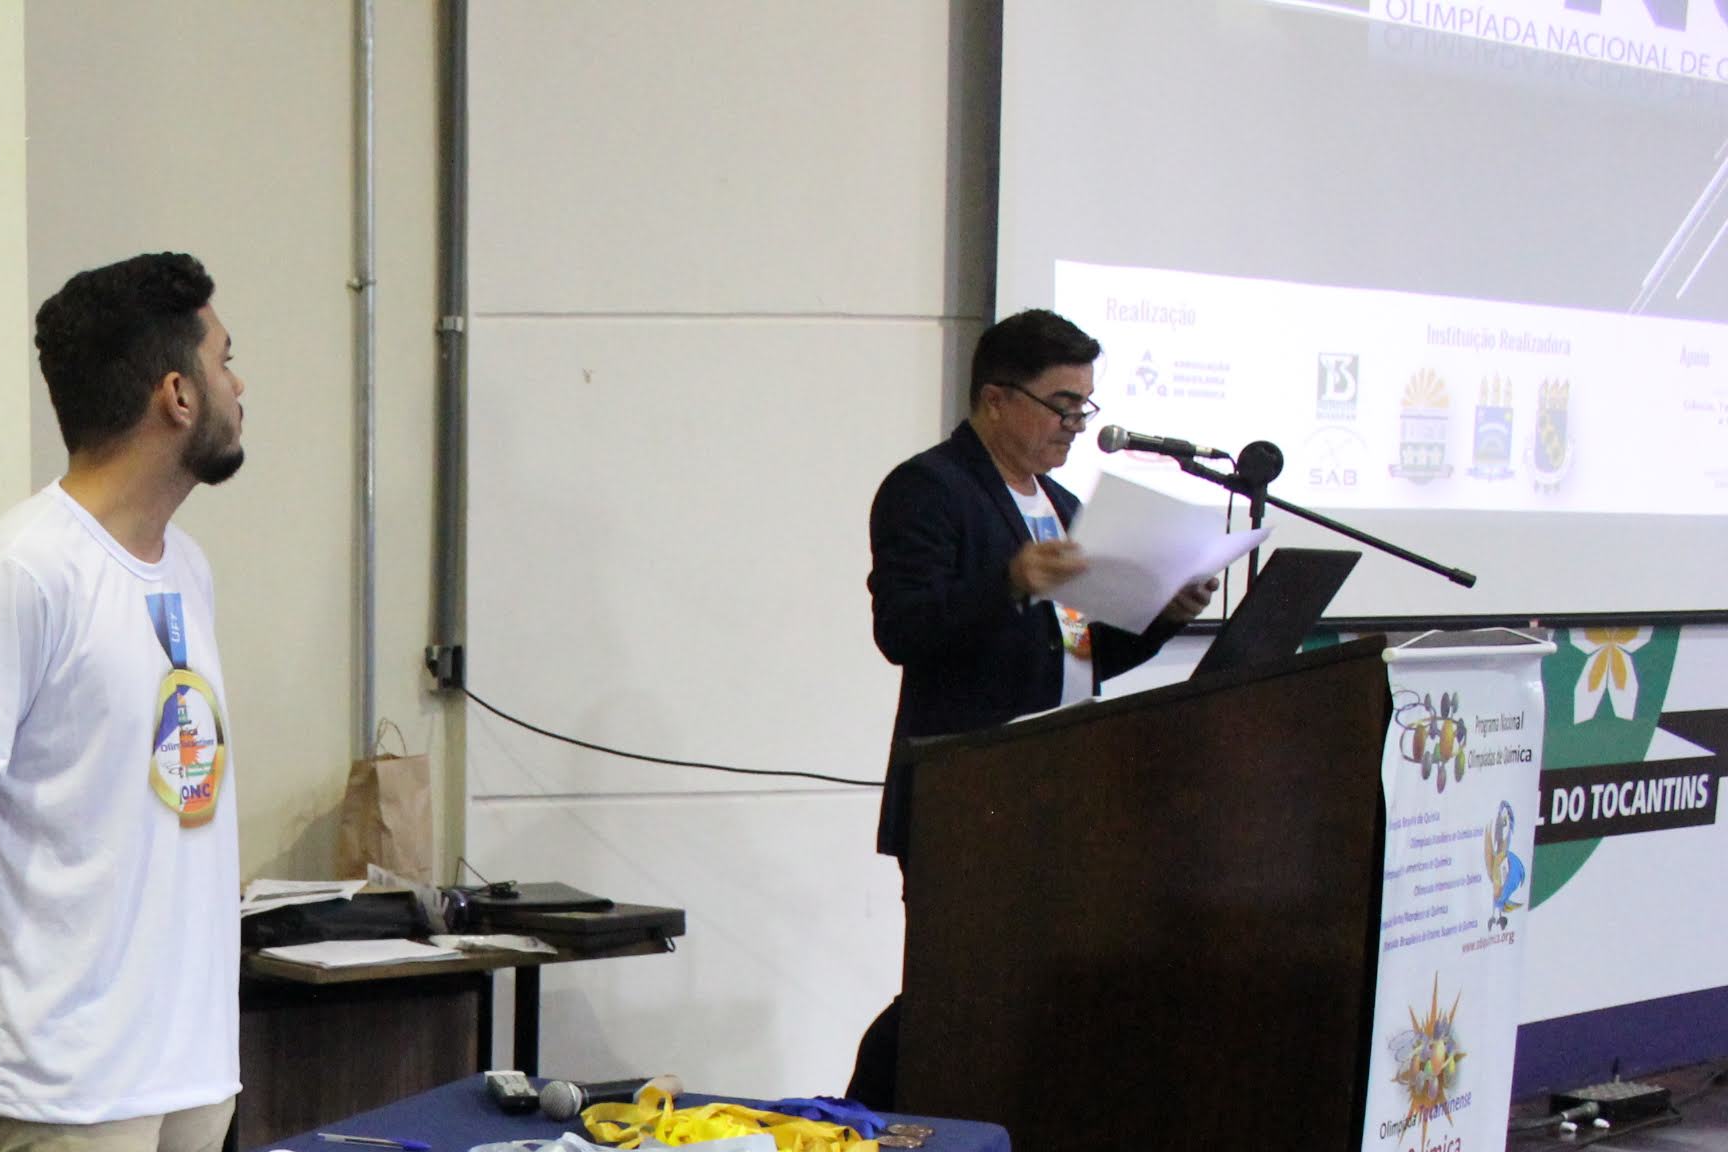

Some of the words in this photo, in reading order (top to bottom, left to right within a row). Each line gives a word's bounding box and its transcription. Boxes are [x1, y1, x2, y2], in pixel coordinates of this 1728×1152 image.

[1385, 0, 1538, 46] OLIMPÍADA
[1546, 24, 1672, 72] NACIONAL
[1680, 51, 1710, 77] DE
[1106, 297, 1196, 331] Realização
[1426, 322, 1496, 352] Instituição
[1499, 331, 1571, 357] Realizadora
[1308, 468, 1358, 487] SAB
[181, 783, 211, 801] ONC
[1551, 786, 1585, 824] DO
[1591, 774, 1709, 820] TOCANTINS
